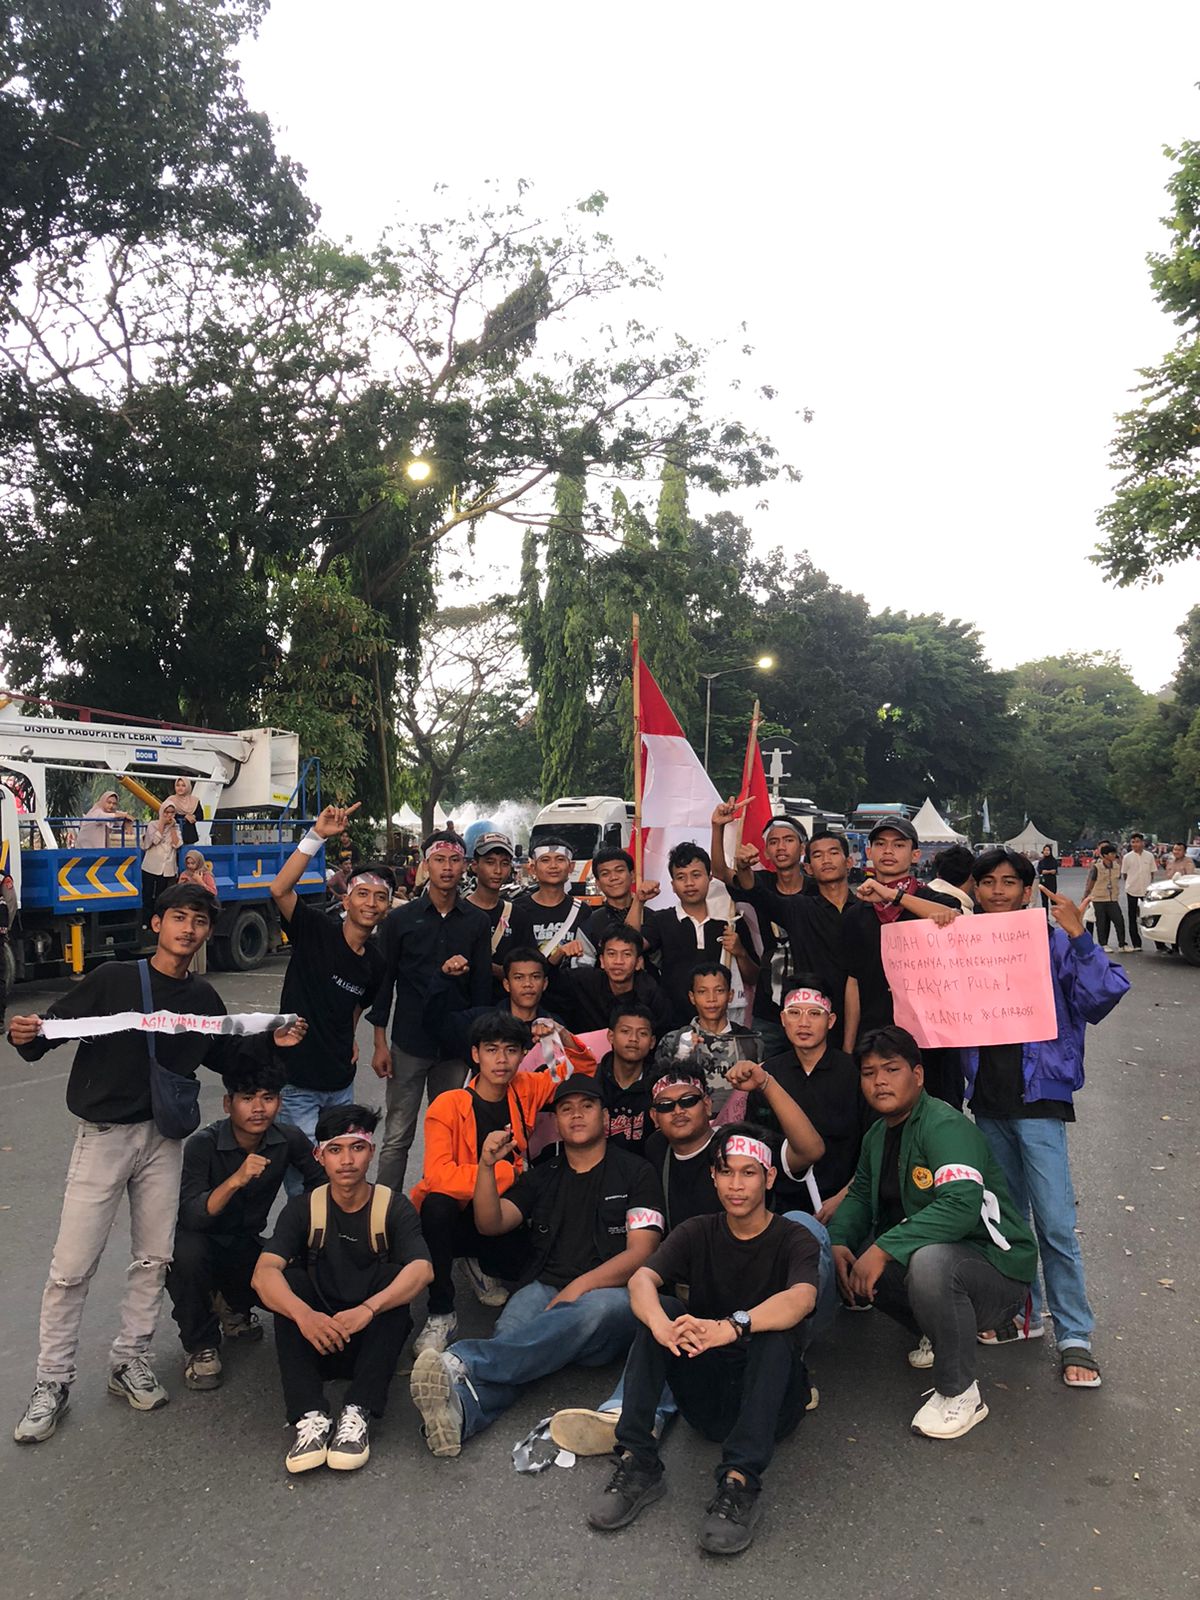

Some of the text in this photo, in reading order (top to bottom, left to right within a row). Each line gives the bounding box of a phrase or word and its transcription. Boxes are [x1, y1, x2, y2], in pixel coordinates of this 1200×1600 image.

[136, 752, 153, 760] BOOM
[948, 933, 983, 948] BAYAR
[992, 930, 1031, 945] MURAH
[903, 977, 959, 998] RAKYAT
